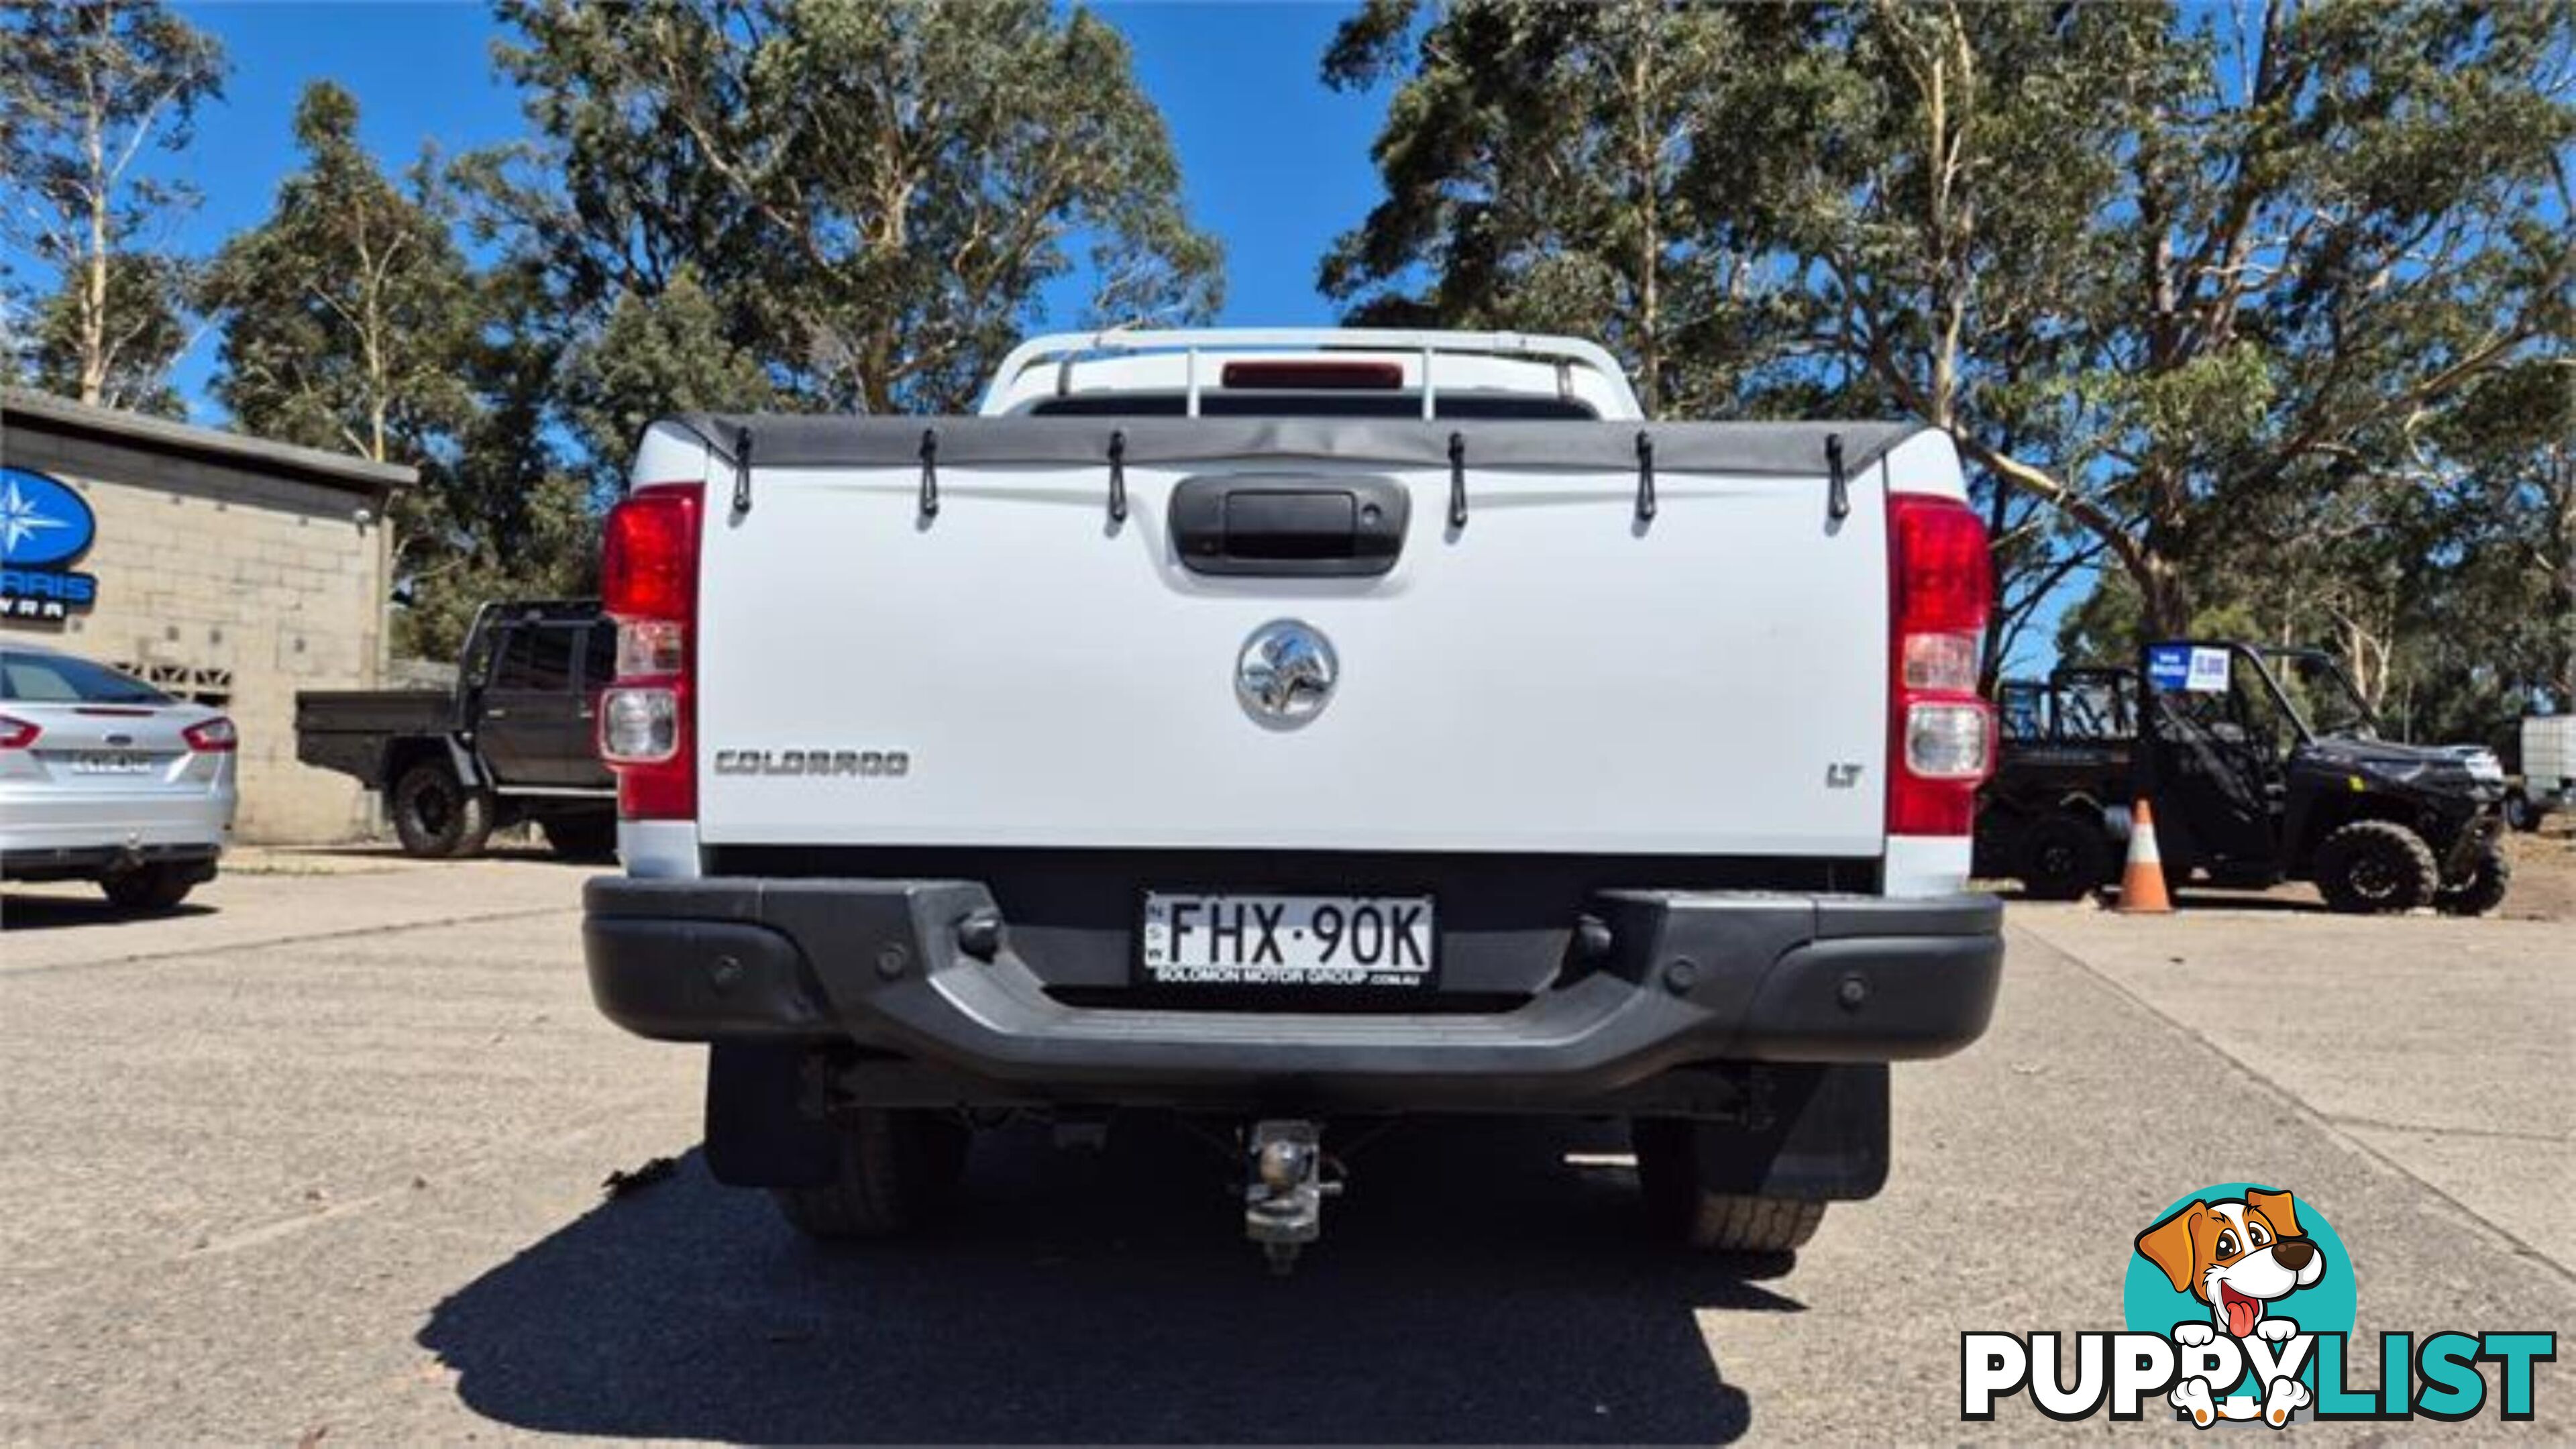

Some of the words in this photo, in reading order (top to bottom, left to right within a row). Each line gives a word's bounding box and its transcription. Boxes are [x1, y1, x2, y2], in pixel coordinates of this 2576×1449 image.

[715, 750, 908, 775] COLORADO
[1826, 763, 1864, 788] LT
[1157, 966, 1240, 982] SOLOMON
[1244, 968, 1305, 983] MOTOR
